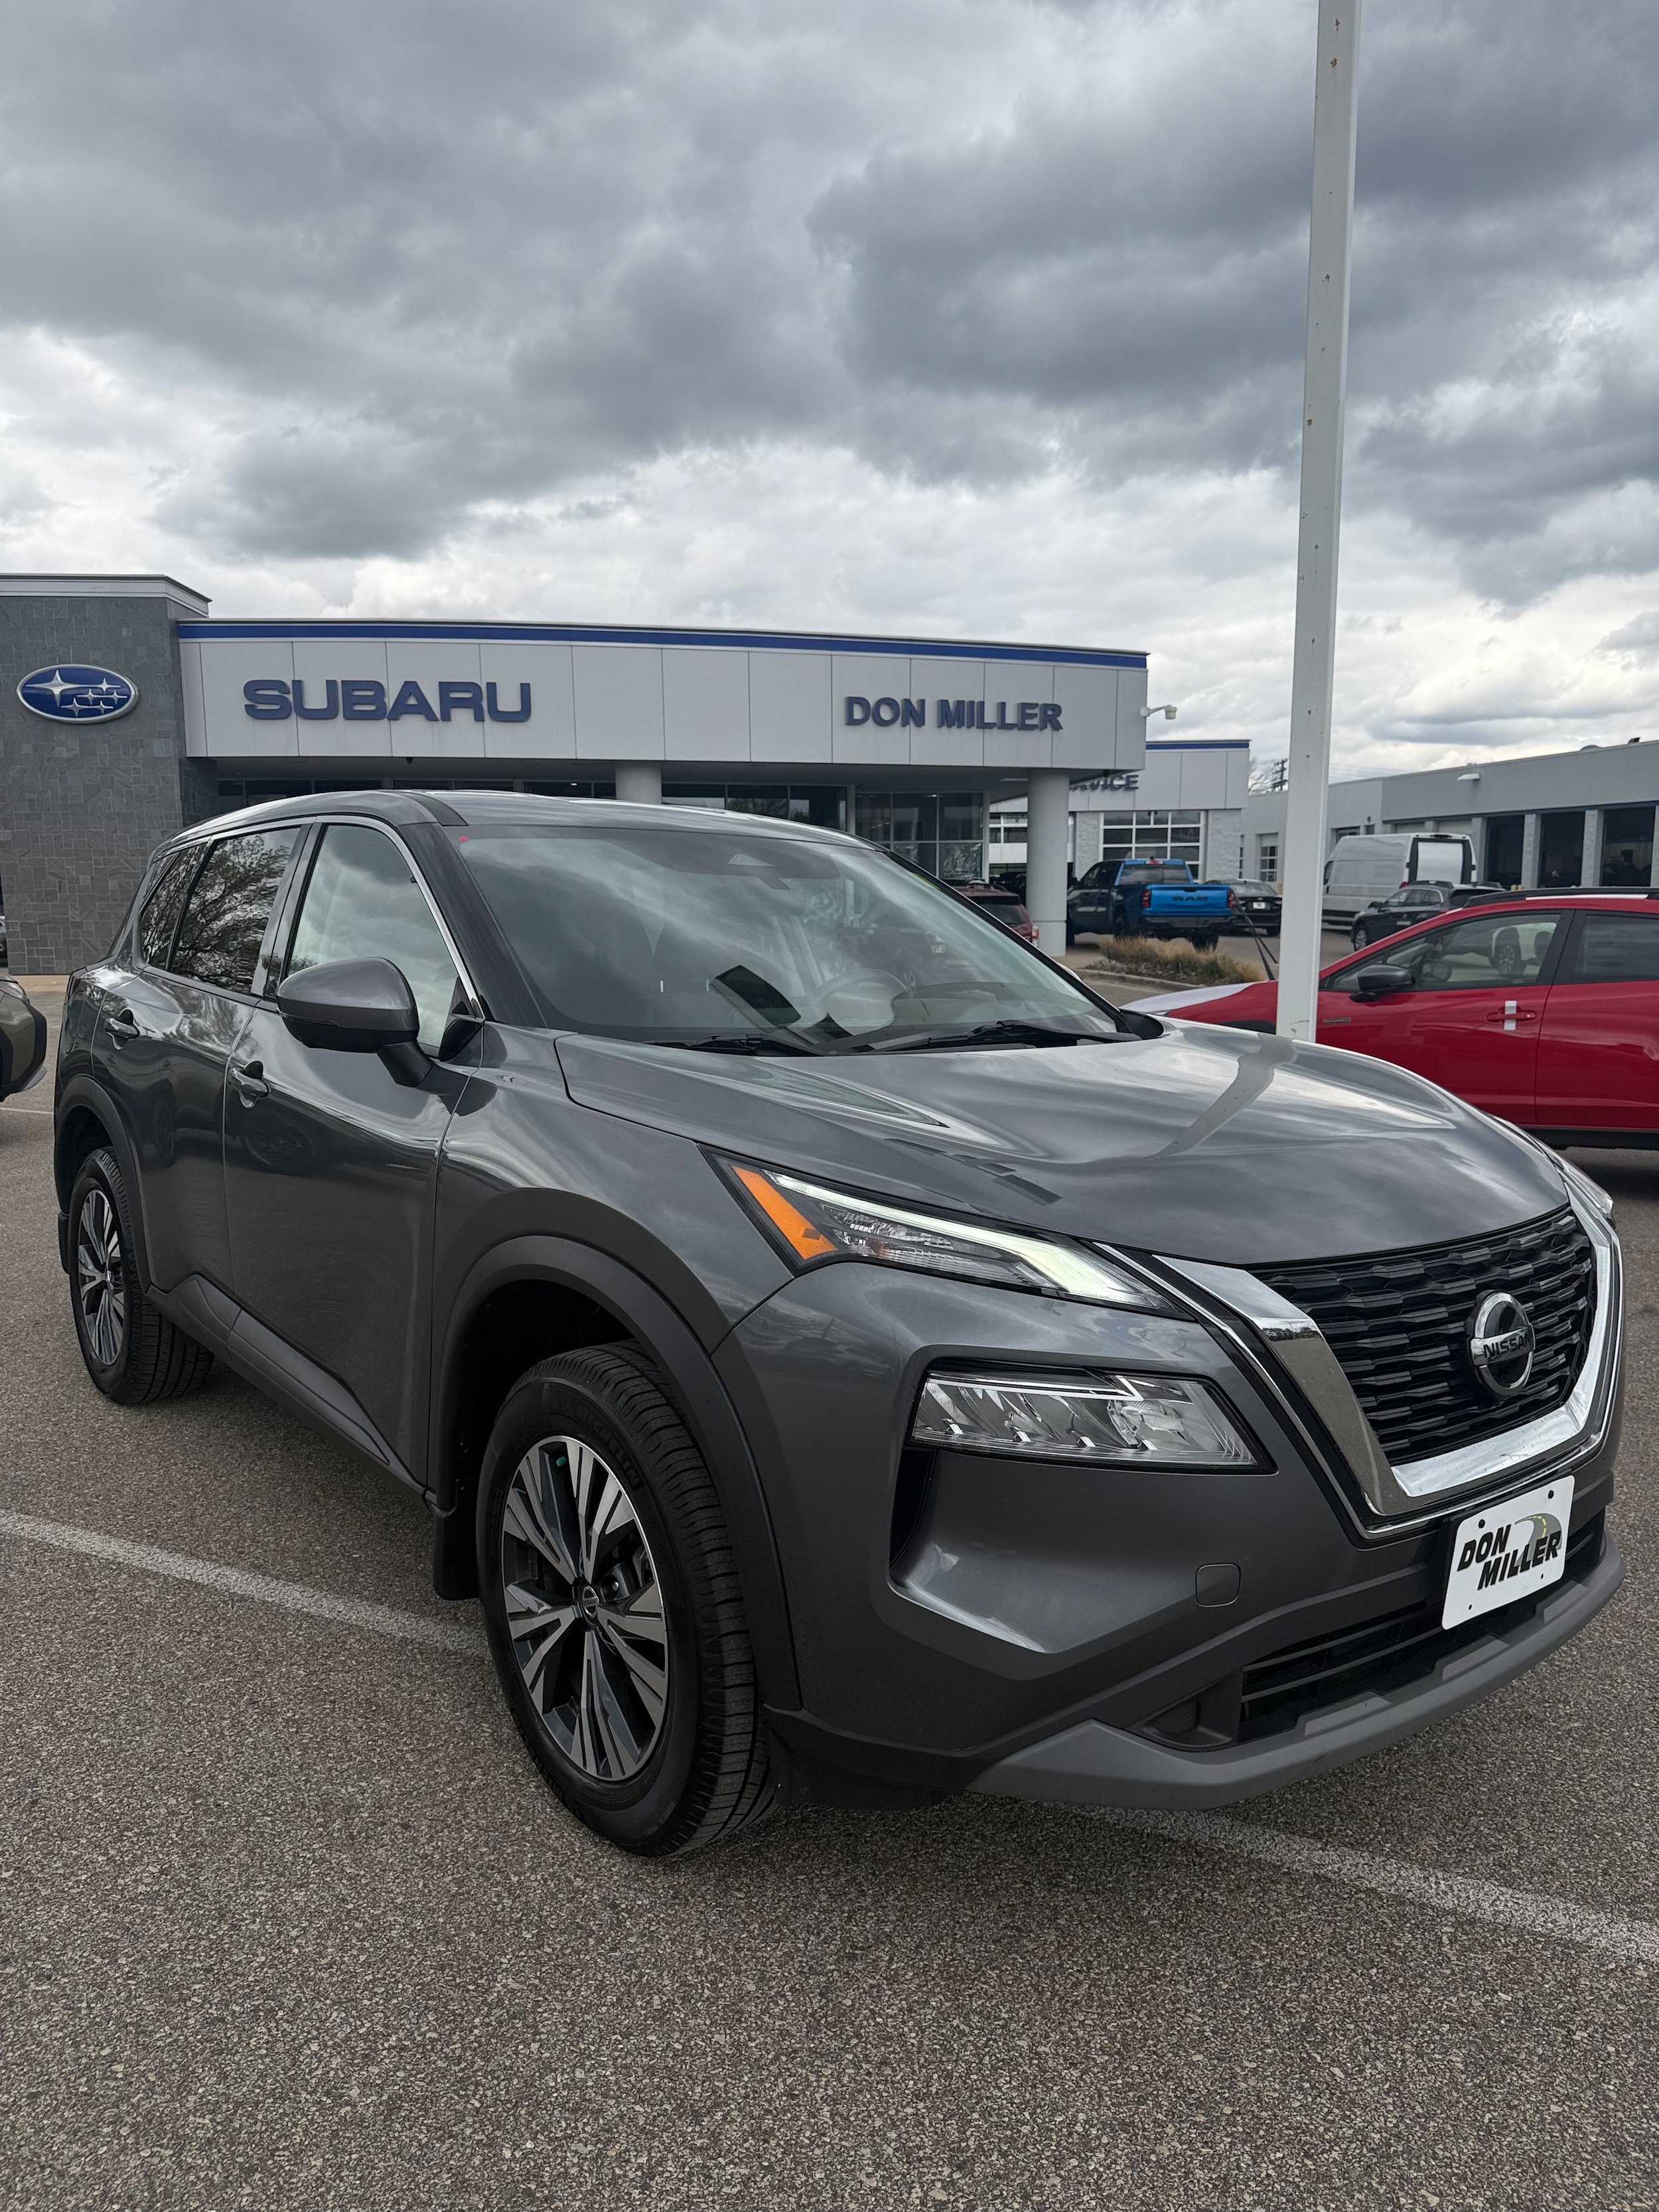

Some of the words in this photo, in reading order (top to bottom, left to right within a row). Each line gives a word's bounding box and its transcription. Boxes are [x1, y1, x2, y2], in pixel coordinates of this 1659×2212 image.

[244, 680, 532, 723] SUBARU
[845, 696, 925, 727] DON
[937, 699, 1063, 731] MILLER
[1483, 1333, 1534, 1360] NISSAN
[1457, 1524, 1512, 1572] DON
[1477, 1530, 1562, 1591] MILLER
